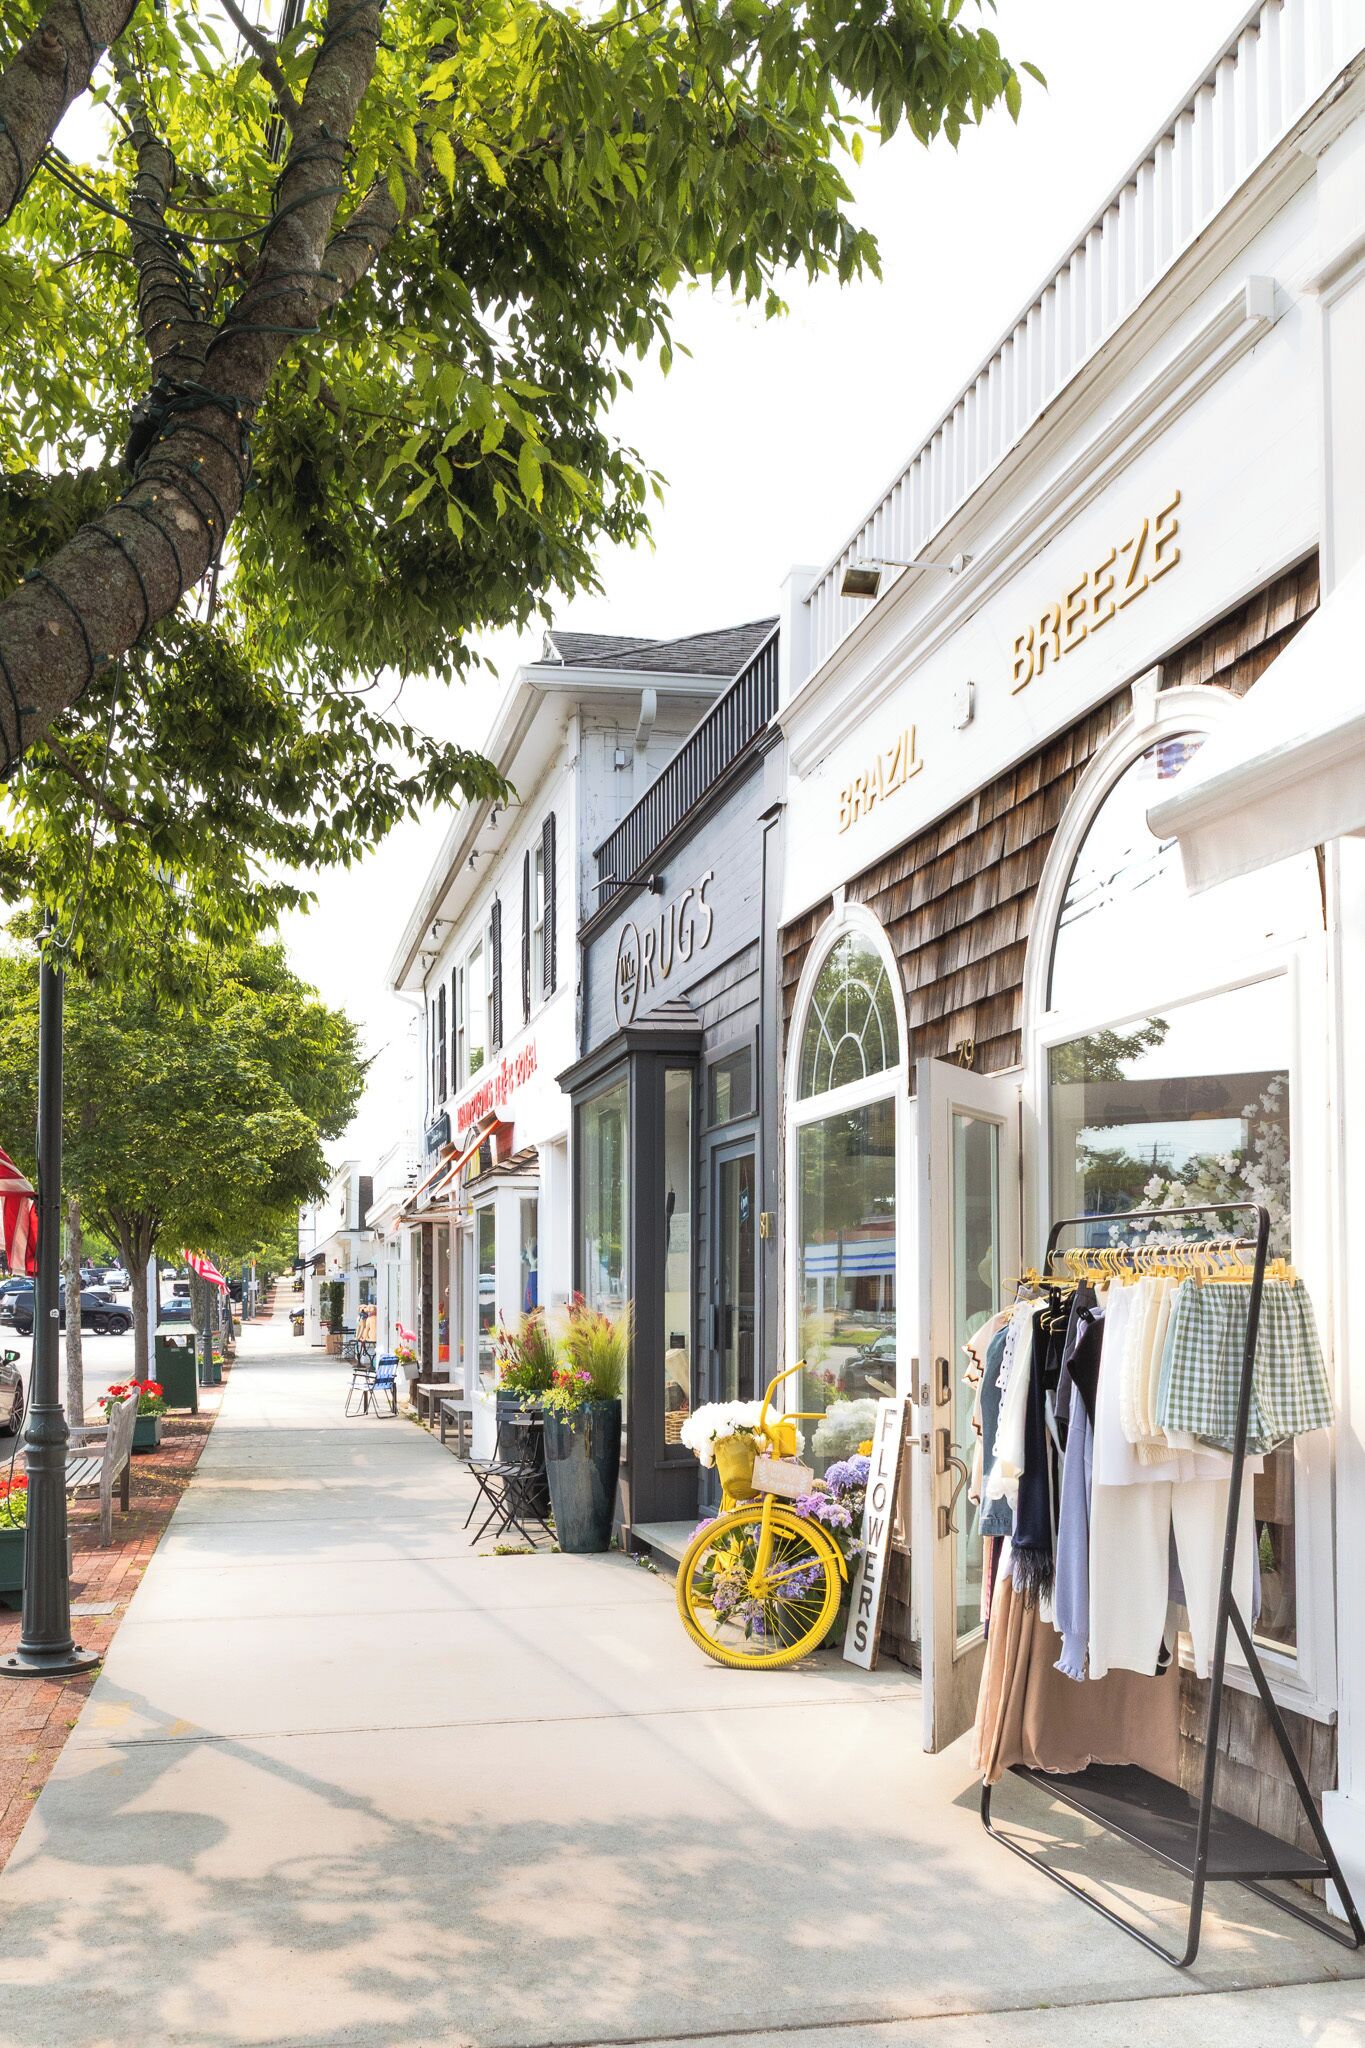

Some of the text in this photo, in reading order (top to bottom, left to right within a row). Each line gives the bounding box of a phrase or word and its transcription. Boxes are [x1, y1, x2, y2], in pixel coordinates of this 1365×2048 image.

[837, 488, 1182, 835] BRAZIL BREEZE
[853, 1408, 898, 1653] FLOWERS
